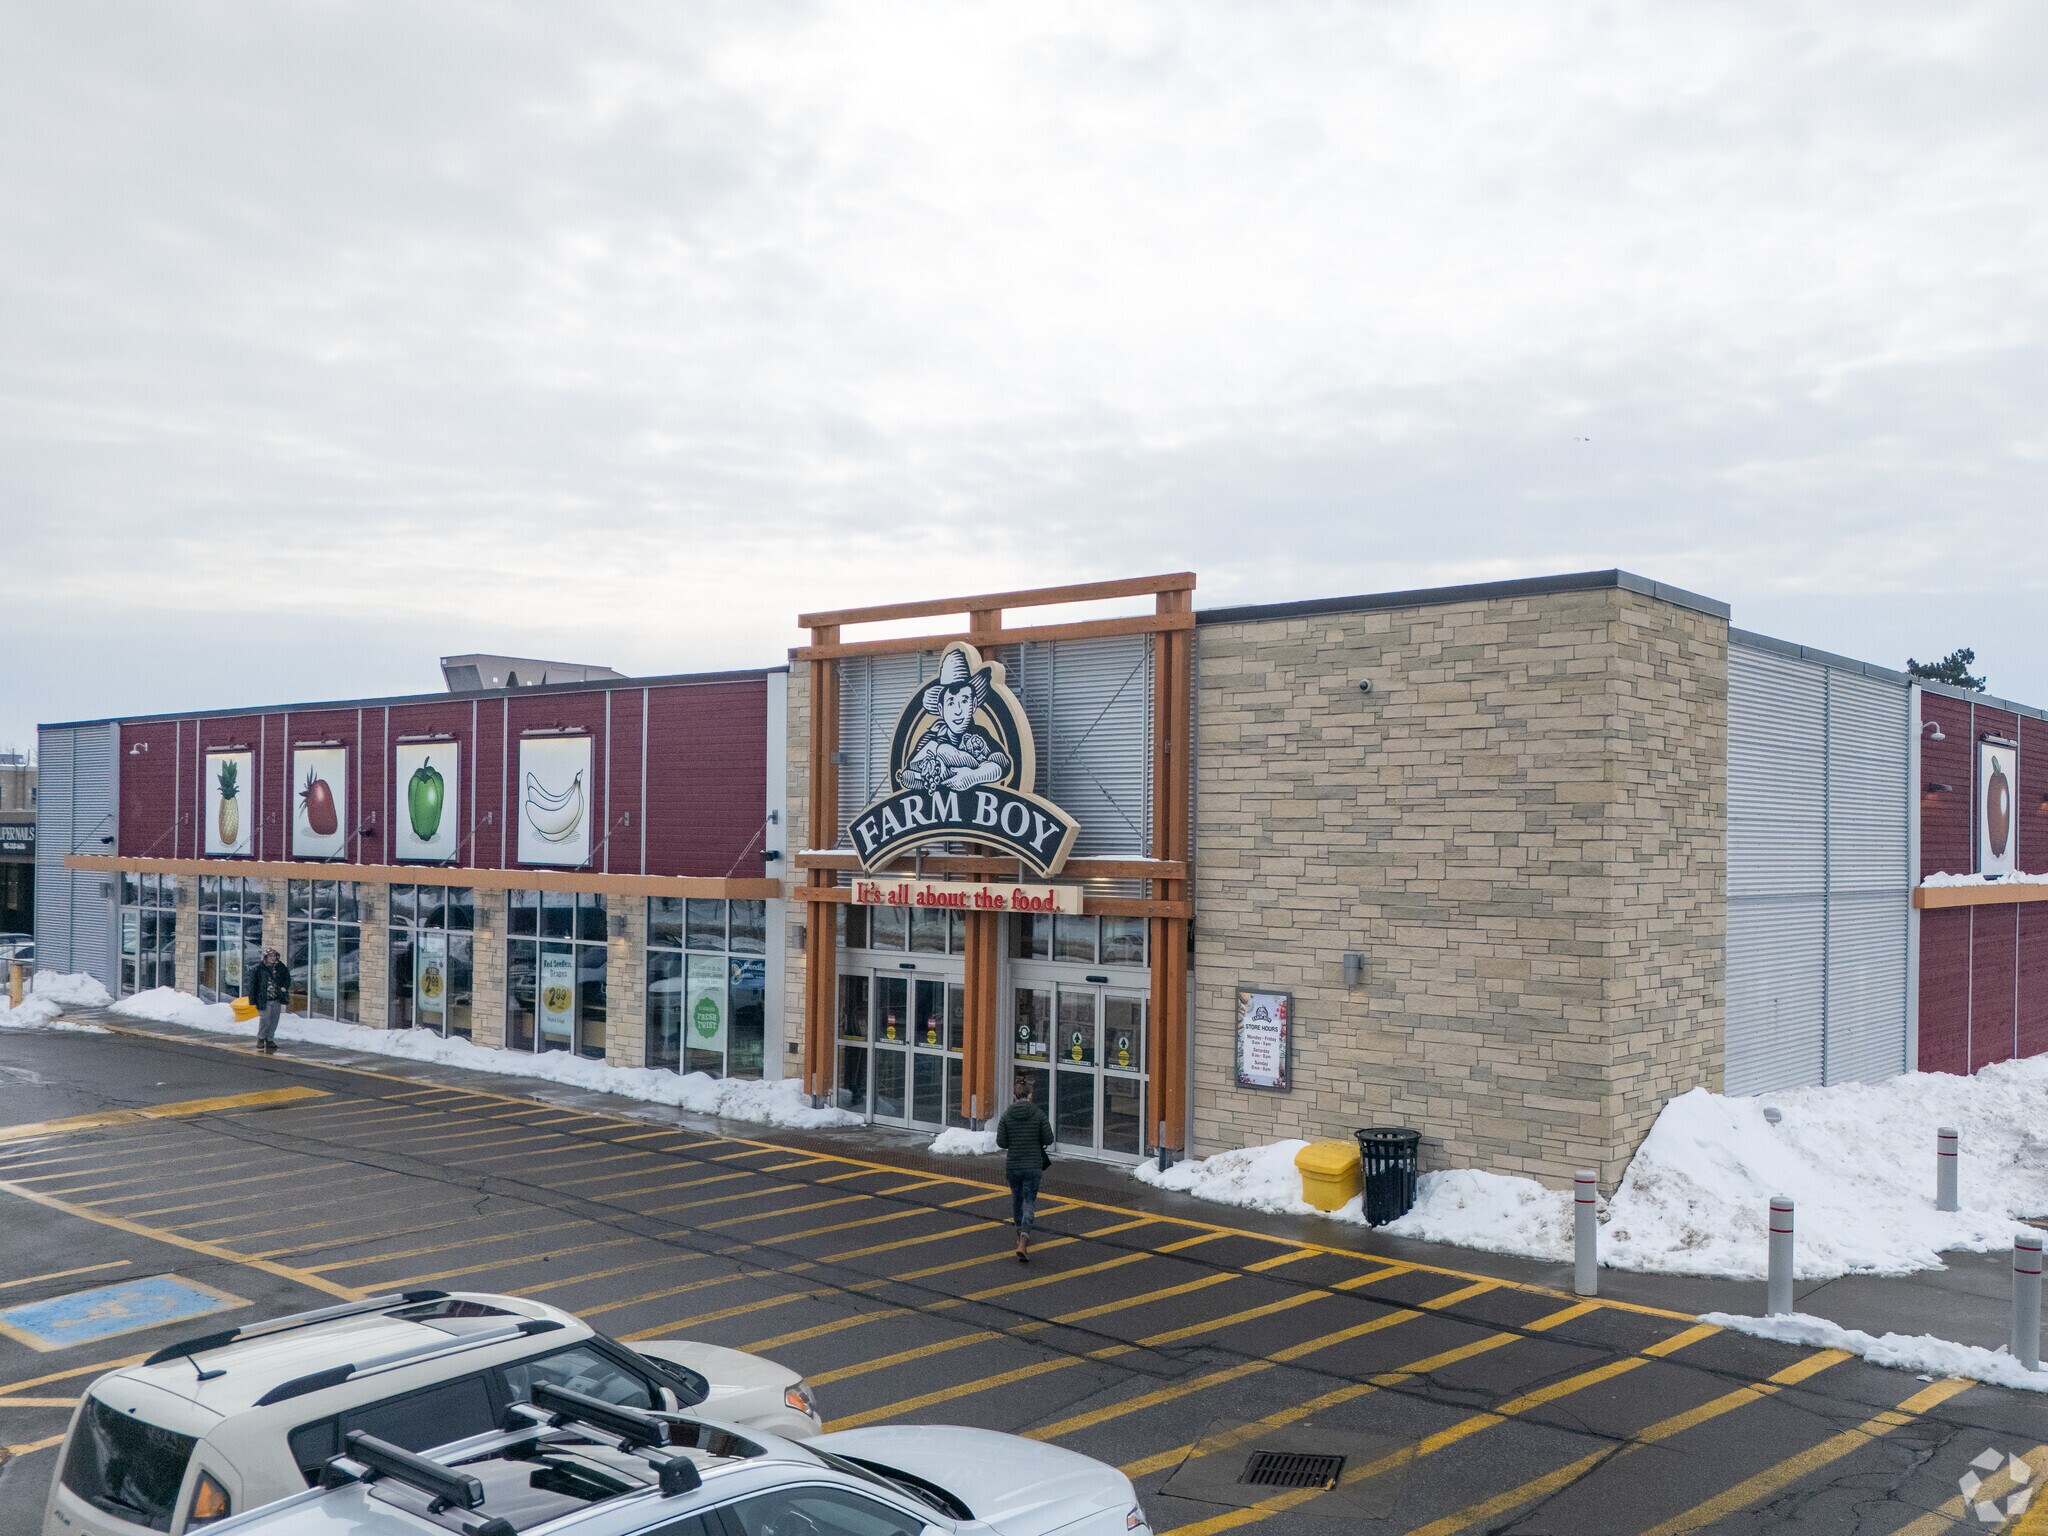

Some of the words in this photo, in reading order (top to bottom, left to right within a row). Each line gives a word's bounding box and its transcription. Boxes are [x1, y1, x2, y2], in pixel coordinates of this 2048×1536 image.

[856, 791, 962, 856] FARM
[972, 790, 1060, 853] BOY
[856, 882, 881, 905] It's
[888, 883, 909, 905] all
[916, 885, 967, 908] about
[974, 886, 1004, 909] the
[1011, 888, 1061, 913] food.
[698, 1021, 717, 1029] TWIST
